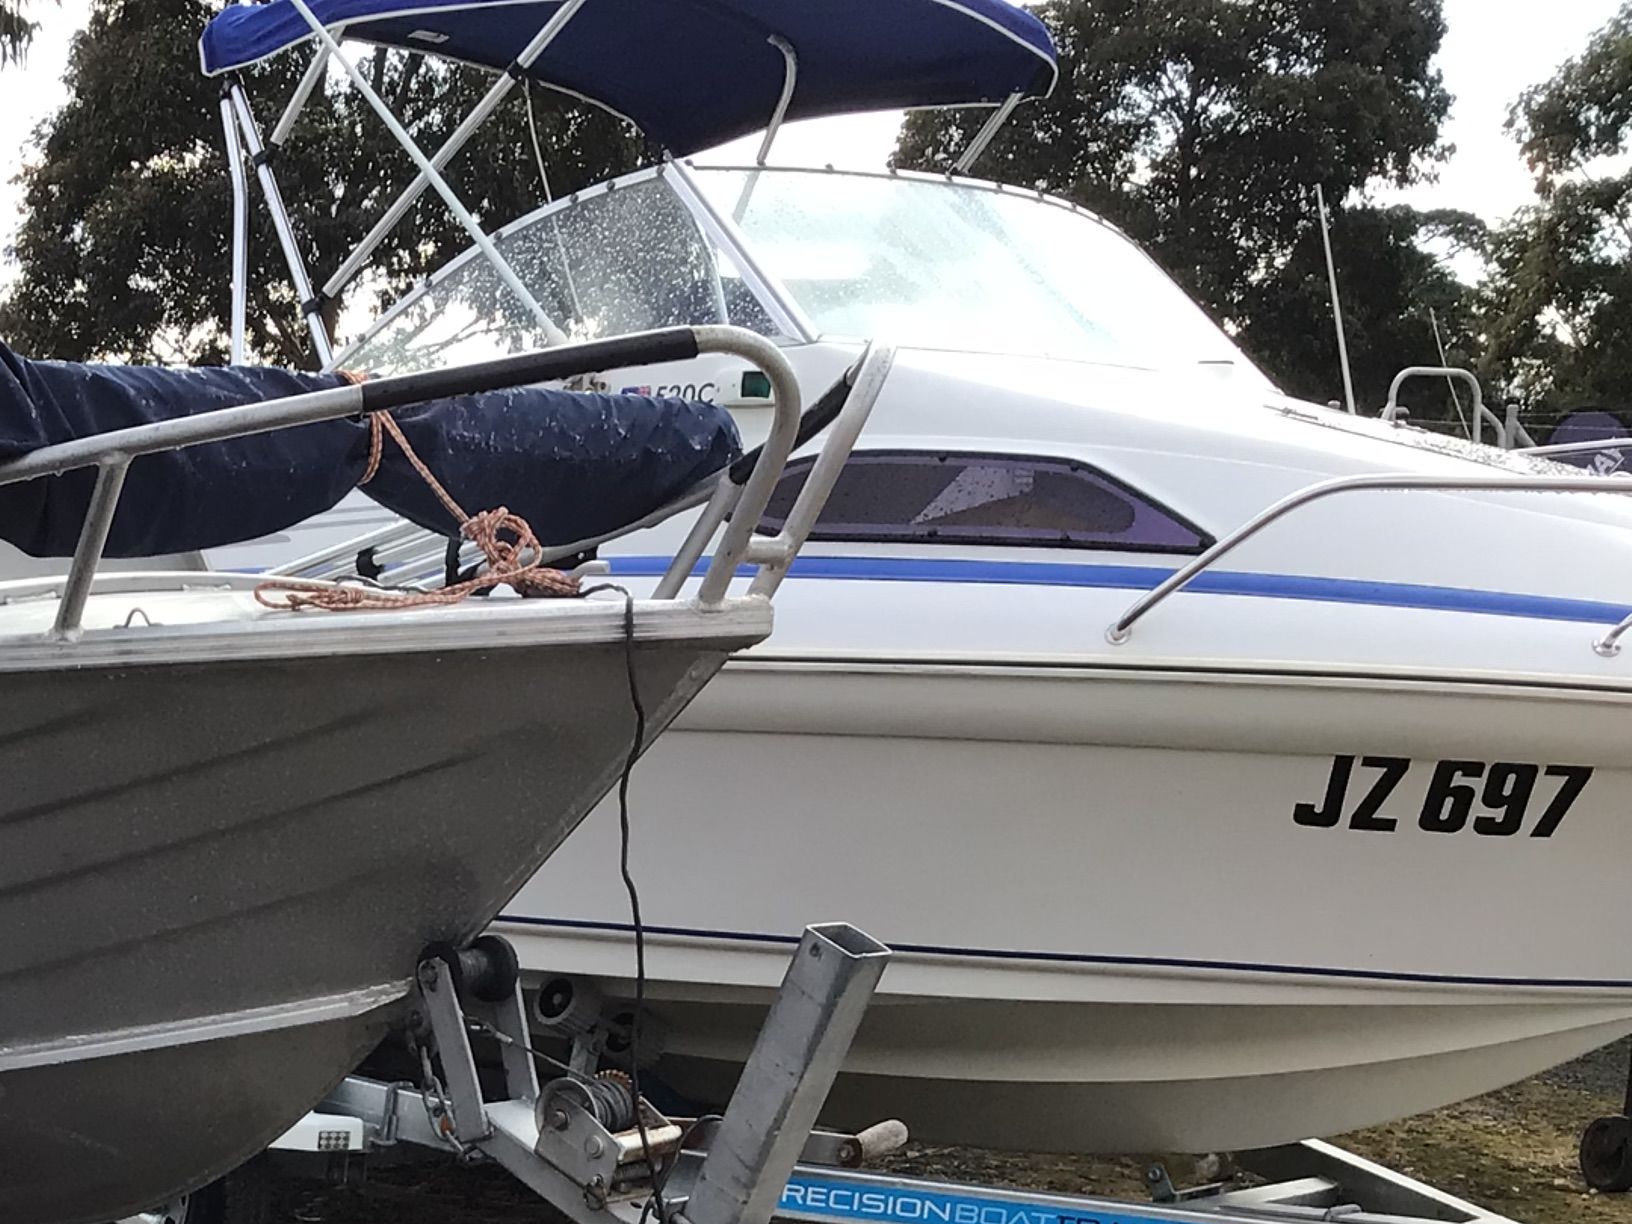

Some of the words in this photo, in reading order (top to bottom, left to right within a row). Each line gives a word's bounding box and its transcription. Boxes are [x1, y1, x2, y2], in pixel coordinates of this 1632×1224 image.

[1293, 755, 1412, 832] JZ
[1418, 759, 1595, 838] 697
[782, 1184, 951, 1222] RECISION
